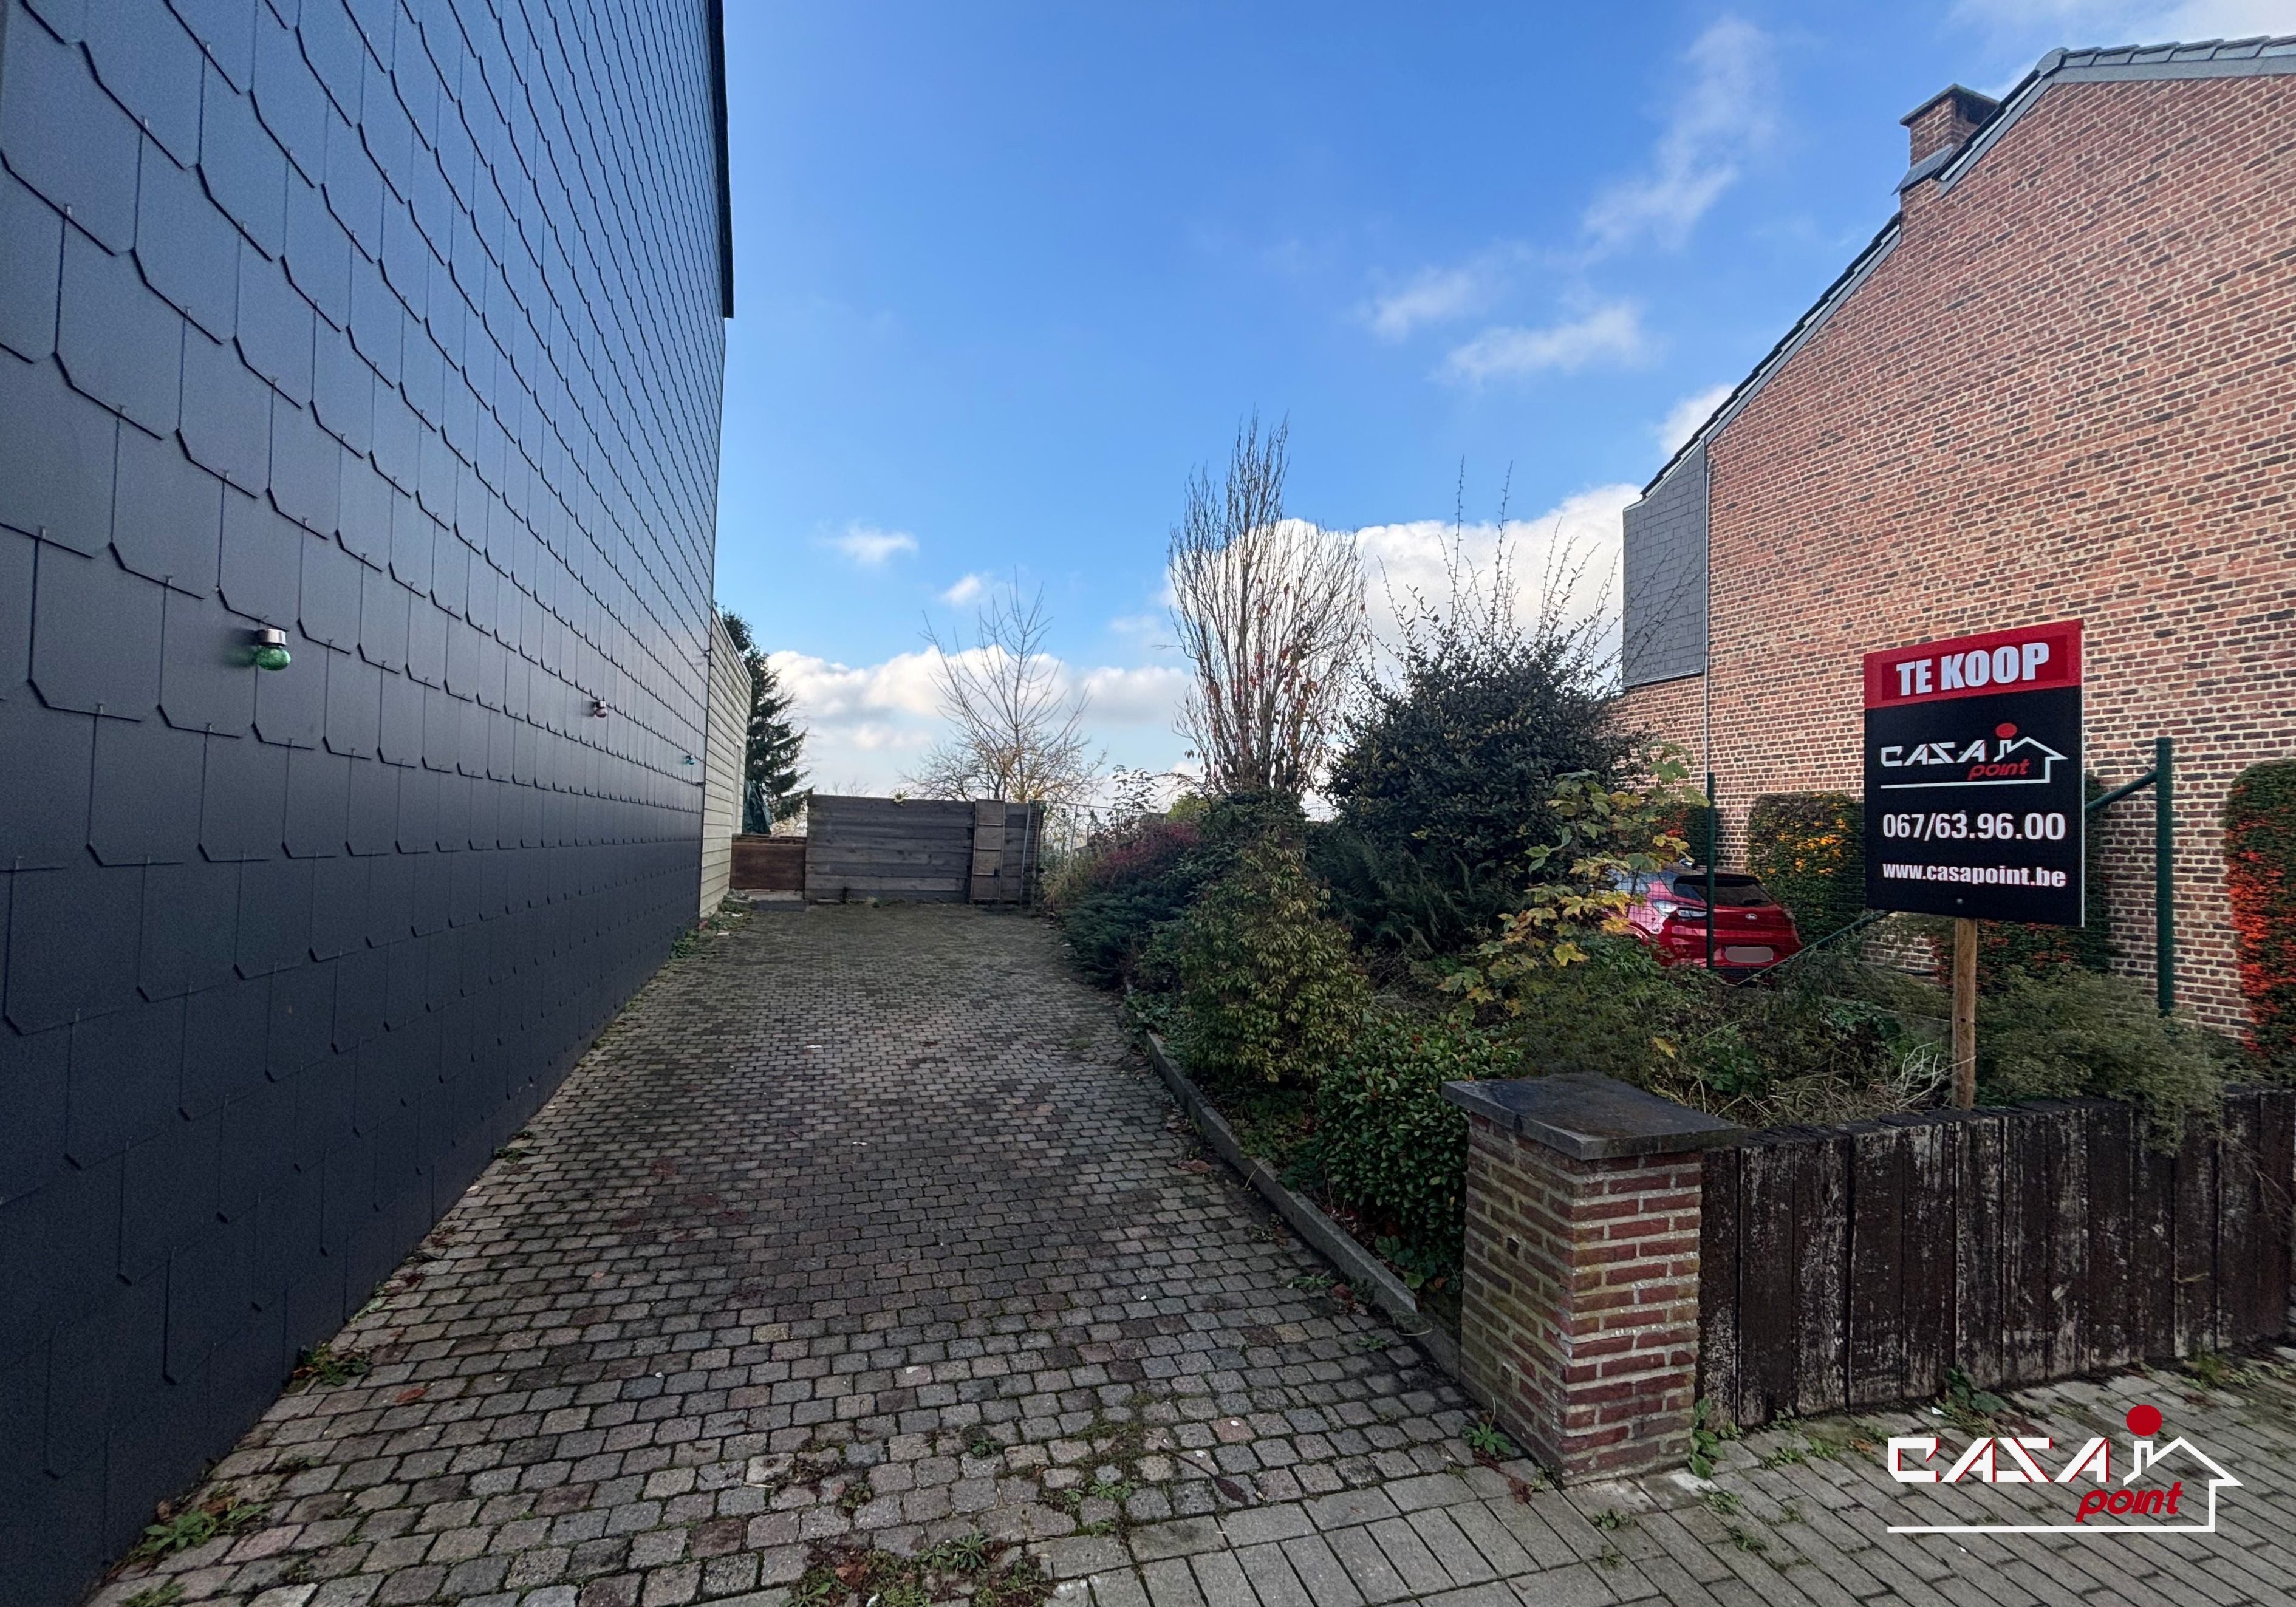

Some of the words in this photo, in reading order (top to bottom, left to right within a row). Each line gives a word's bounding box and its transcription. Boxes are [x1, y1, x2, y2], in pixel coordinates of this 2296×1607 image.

[1896, 660, 1932, 696] TE
[1941, 642, 2050, 691] KOOP
[1967, 759, 2031, 780] point
[1883, 813, 2066, 841] 067/63.96.00
[1882, 863, 2066, 887] www.casapoint.be
